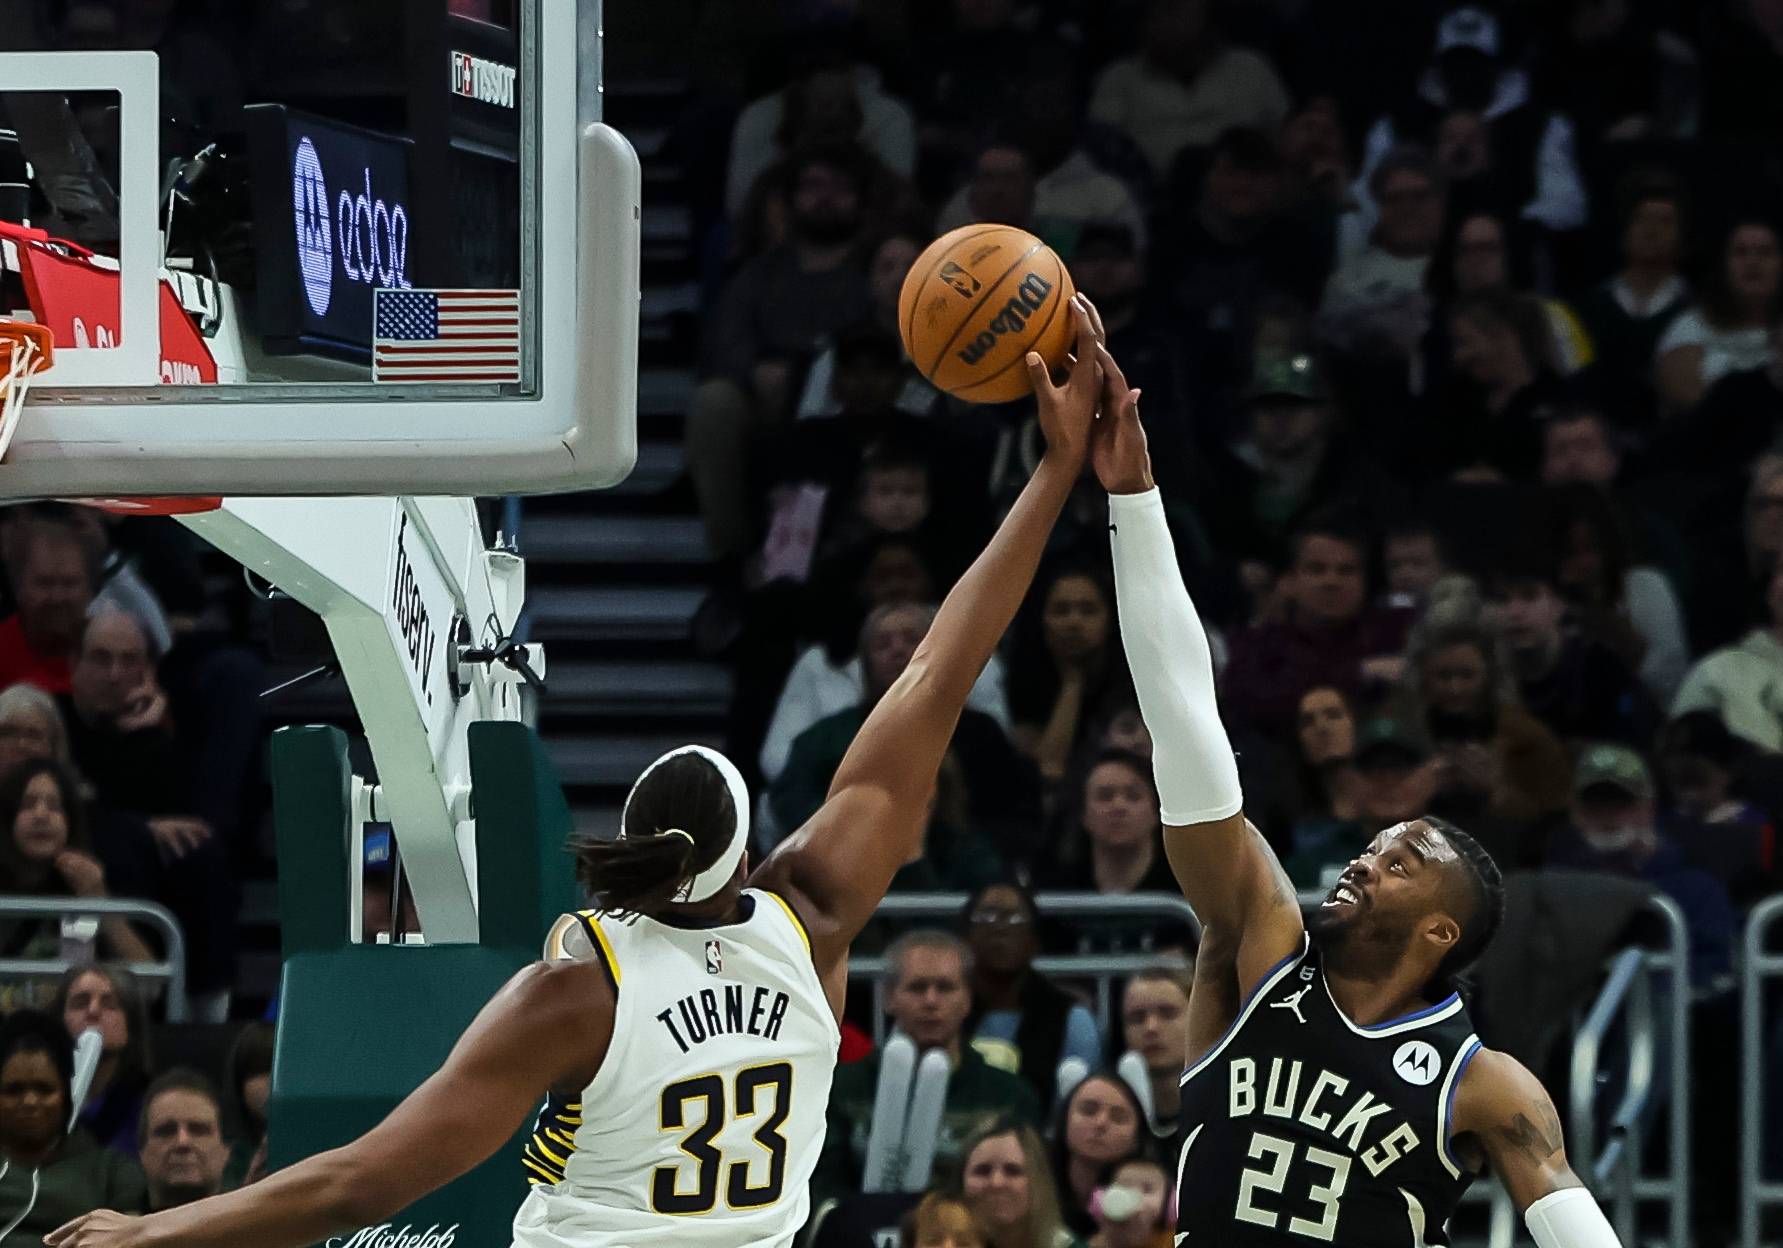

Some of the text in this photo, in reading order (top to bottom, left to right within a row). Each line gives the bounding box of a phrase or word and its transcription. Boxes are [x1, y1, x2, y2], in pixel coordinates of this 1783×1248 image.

[958, 271, 1052, 365] Wilson
[656, 984, 789, 1054] TURNER
[650, 1059, 793, 1215] 33
[1229, 1057, 1420, 1177] BUCKS
[1234, 1131, 1352, 1242] 23
